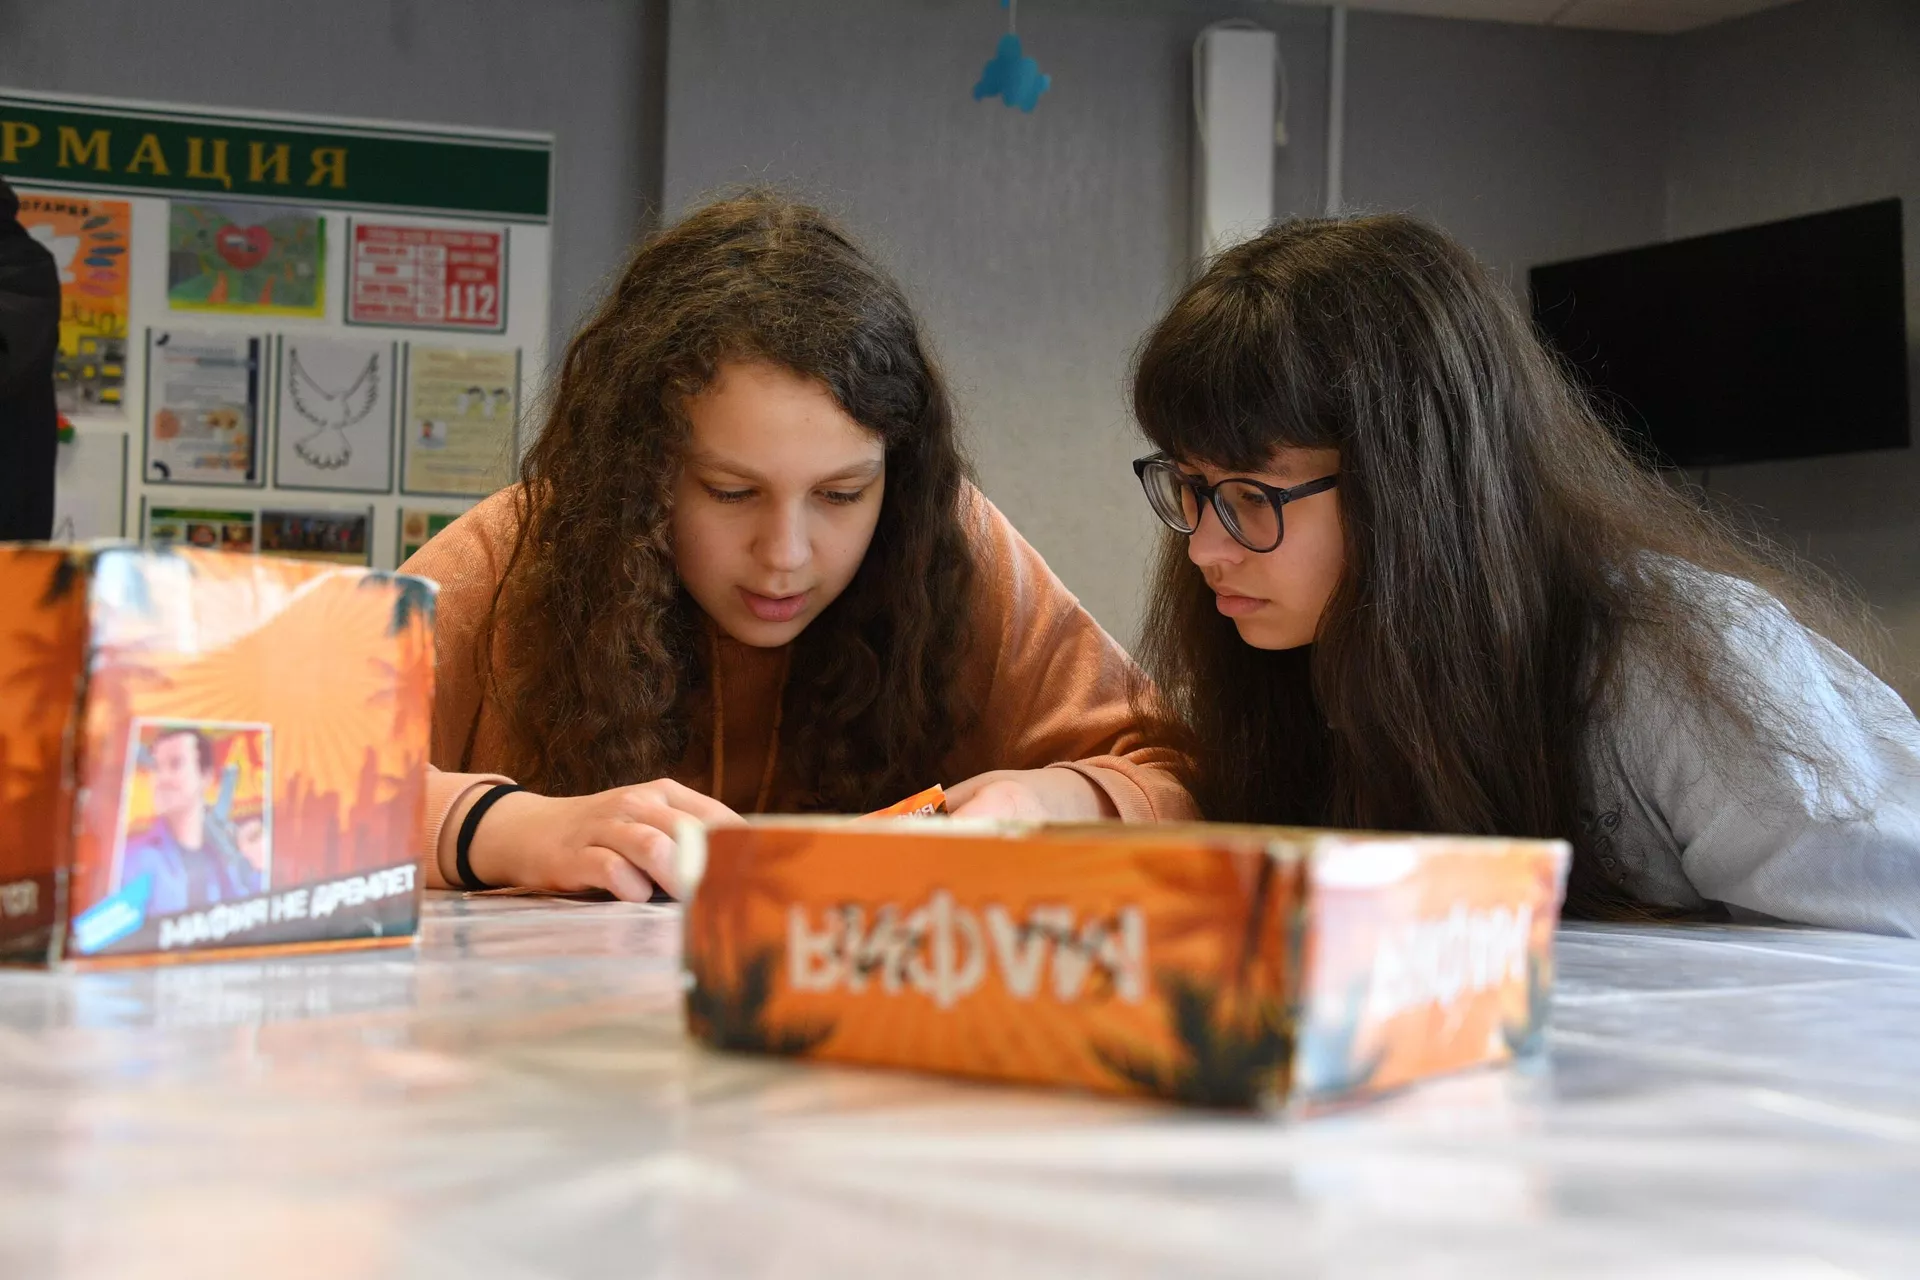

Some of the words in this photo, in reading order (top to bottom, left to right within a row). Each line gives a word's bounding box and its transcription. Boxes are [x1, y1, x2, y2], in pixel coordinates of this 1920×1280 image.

[0, 121, 348, 189] РМАЦИЯ
[450, 284, 495, 320] 112
[159, 897, 269, 949] МАФИЯ
[271, 888, 309, 922] НЕ
[787, 888, 1147, 1009] МАФИЯ
